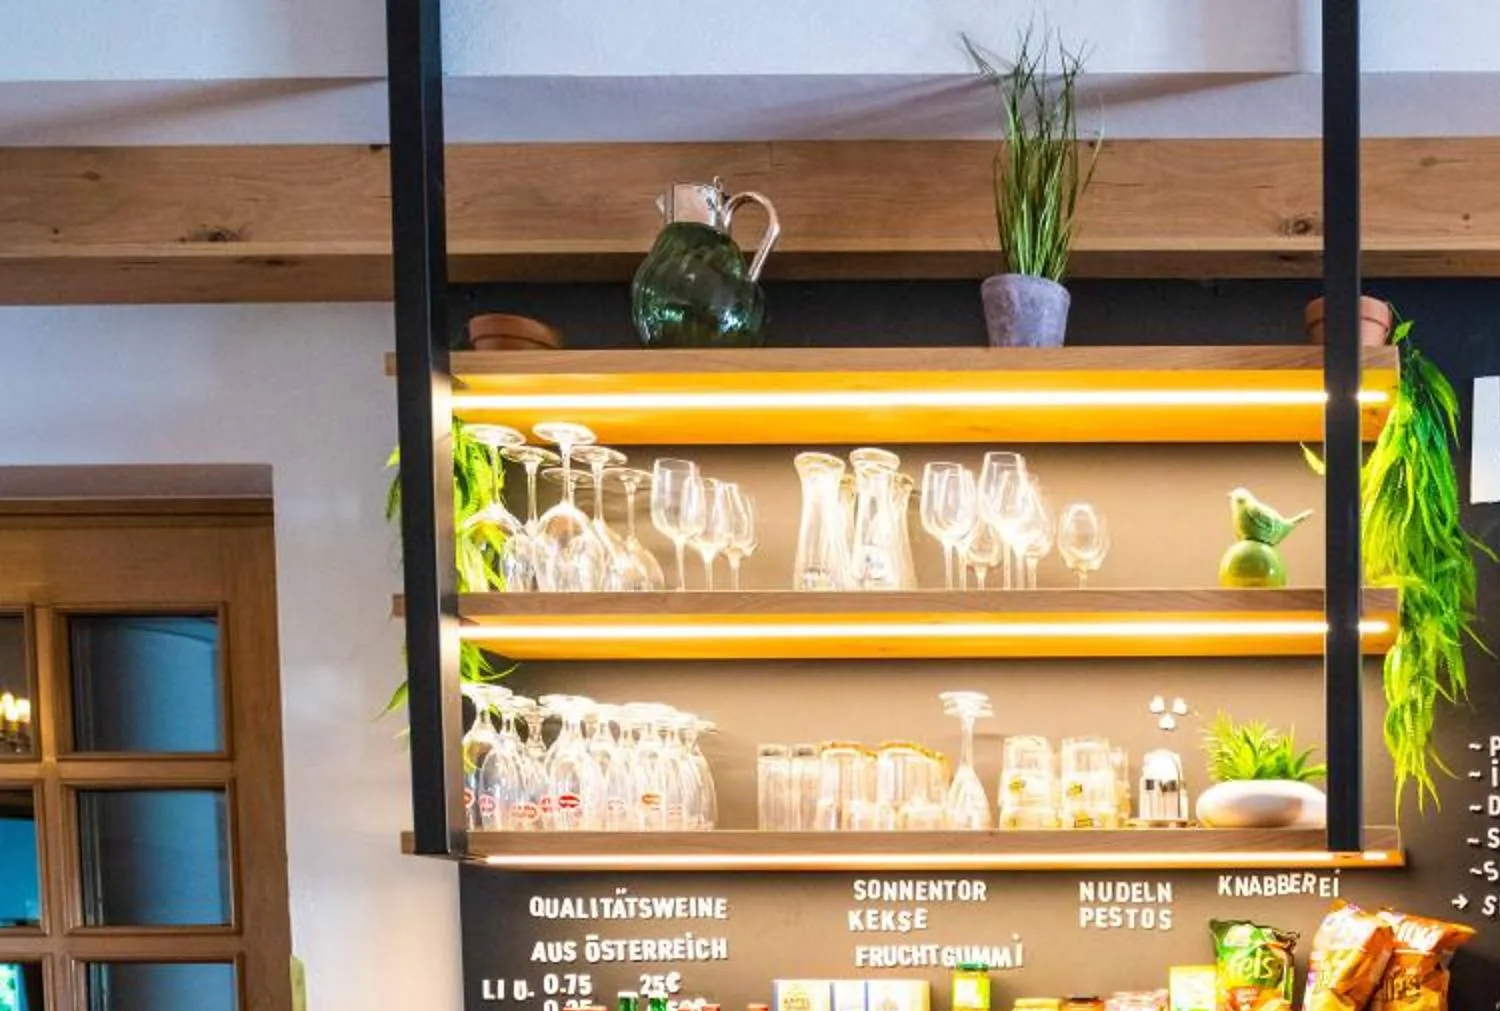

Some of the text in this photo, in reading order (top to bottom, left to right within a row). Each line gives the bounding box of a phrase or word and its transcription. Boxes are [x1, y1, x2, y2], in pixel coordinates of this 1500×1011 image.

[852, 879, 988, 902] SONNENTOR
[1079, 881, 1174, 904] NUDELN
[528, 887, 729, 920] QUALITÄTSWEINE
[847, 907, 929, 933] KEKSE
[1079, 906, 1174, 930] PESTOS
[530, 941, 578, 963] AUS
[543, 972, 593, 996] 0.75
